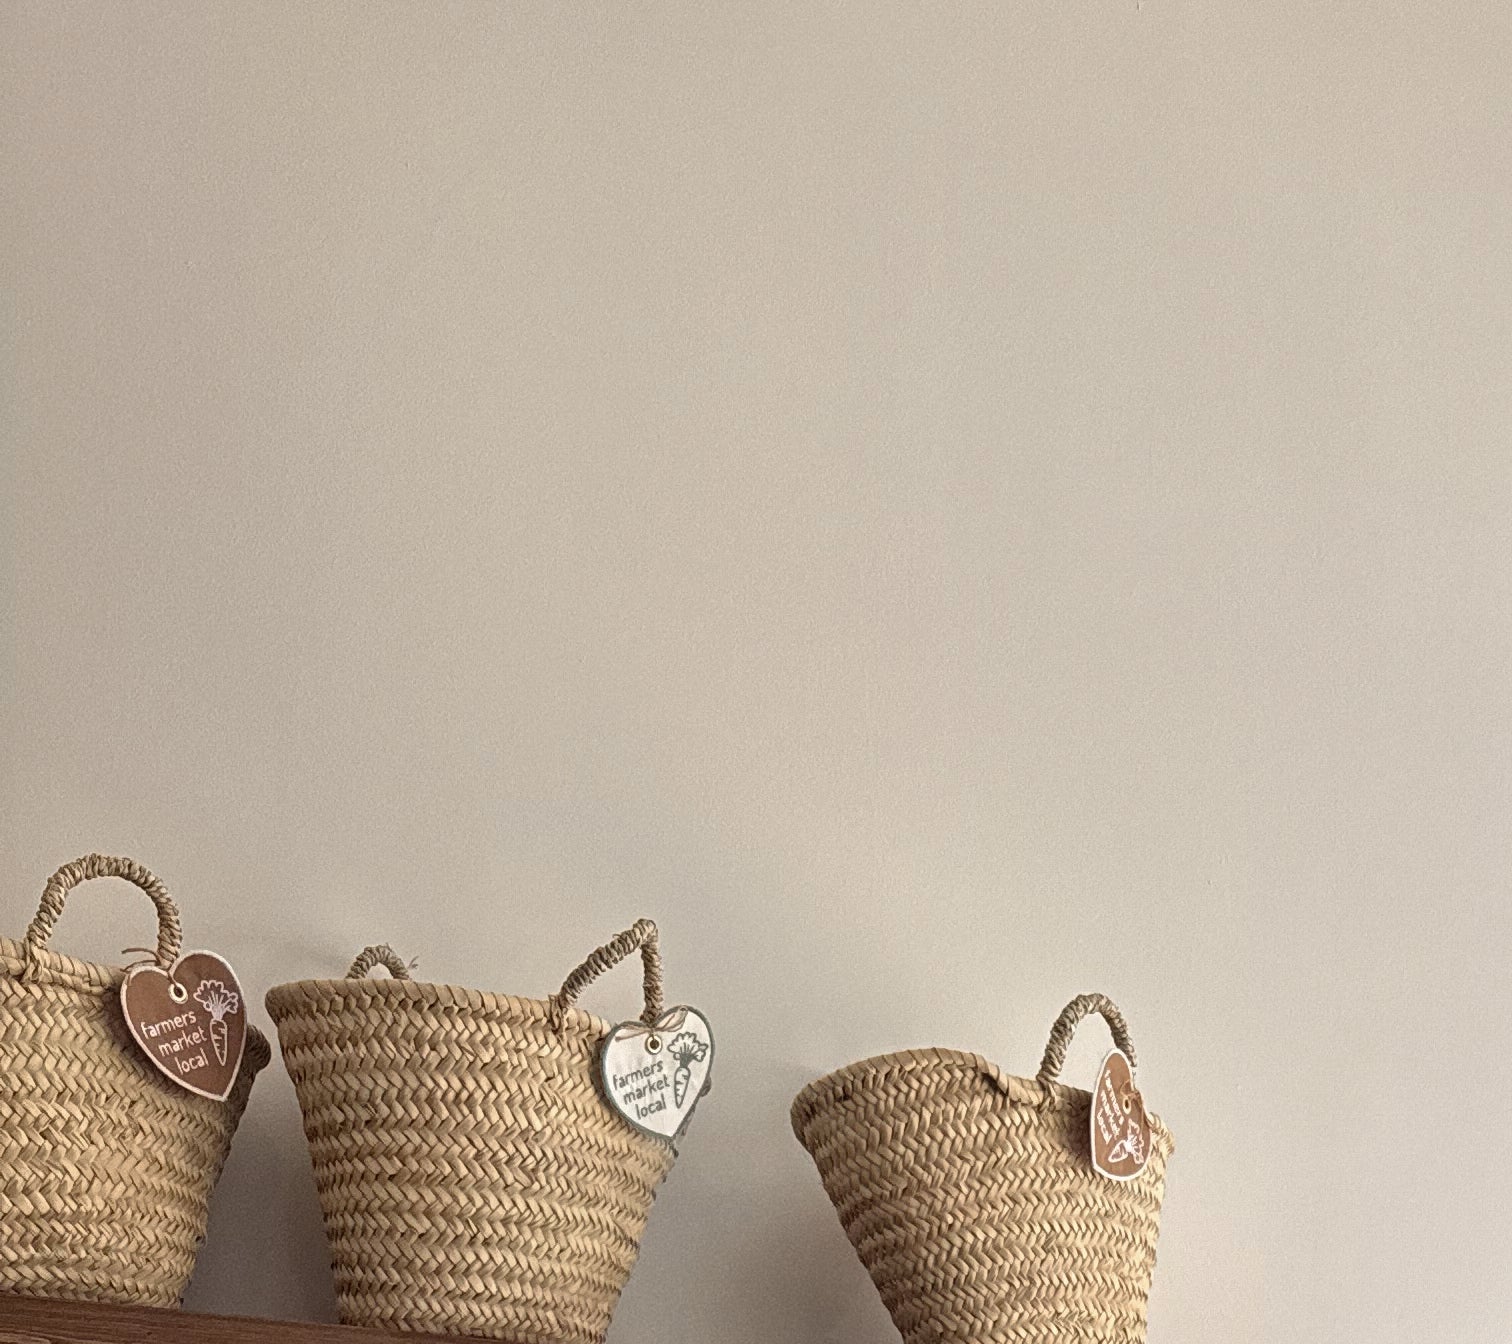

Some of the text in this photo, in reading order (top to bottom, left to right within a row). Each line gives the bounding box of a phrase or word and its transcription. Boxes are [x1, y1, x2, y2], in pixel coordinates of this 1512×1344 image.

[141, 1011, 197, 1040] farmers
[158, 1027, 208, 1057] market
[174, 1048, 209, 1076] local
[613, 1060, 664, 1091] farmers
[623, 1074, 671, 1105] market
[635, 1093, 667, 1120] local
